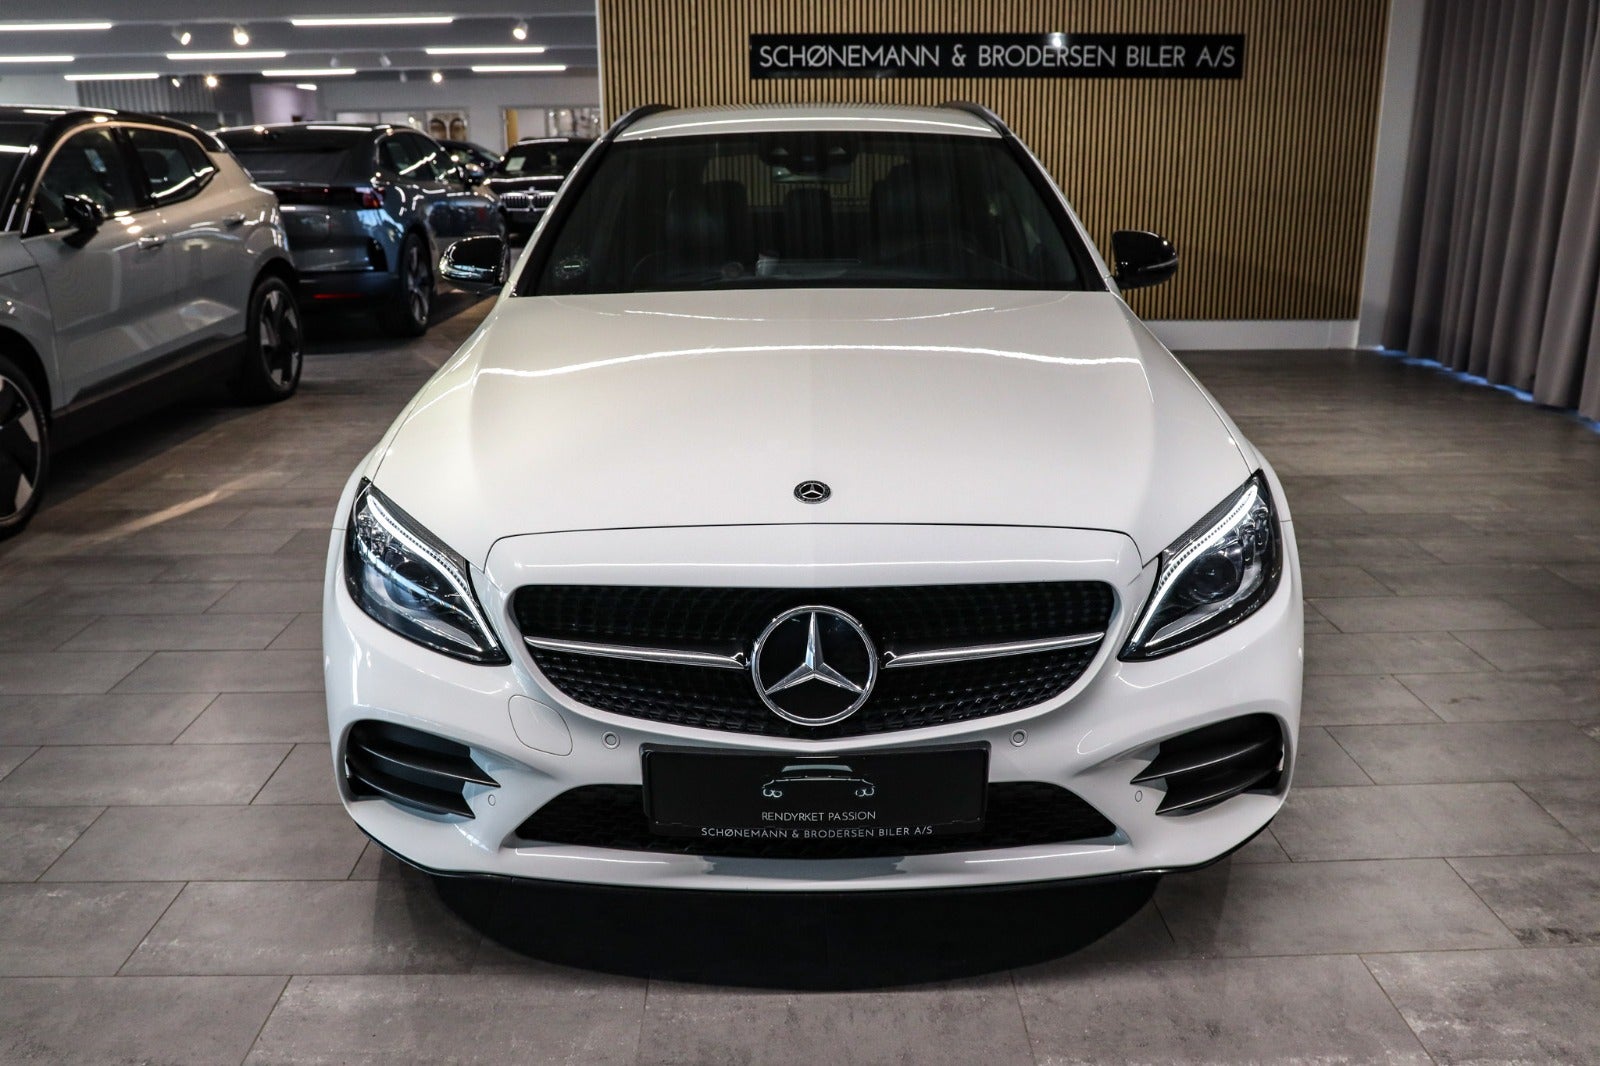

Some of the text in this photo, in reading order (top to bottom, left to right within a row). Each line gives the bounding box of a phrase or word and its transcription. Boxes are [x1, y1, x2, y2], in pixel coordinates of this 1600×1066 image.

[759, 44, 1236, 68] SCHØNEMANN & BRODERSEN BILER A/S
[761, 811, 876, 822] RENDYRKET PASSION
[701, 826, 933, 838] SCHØNEMANN & BRODERSEN BILER A/S
